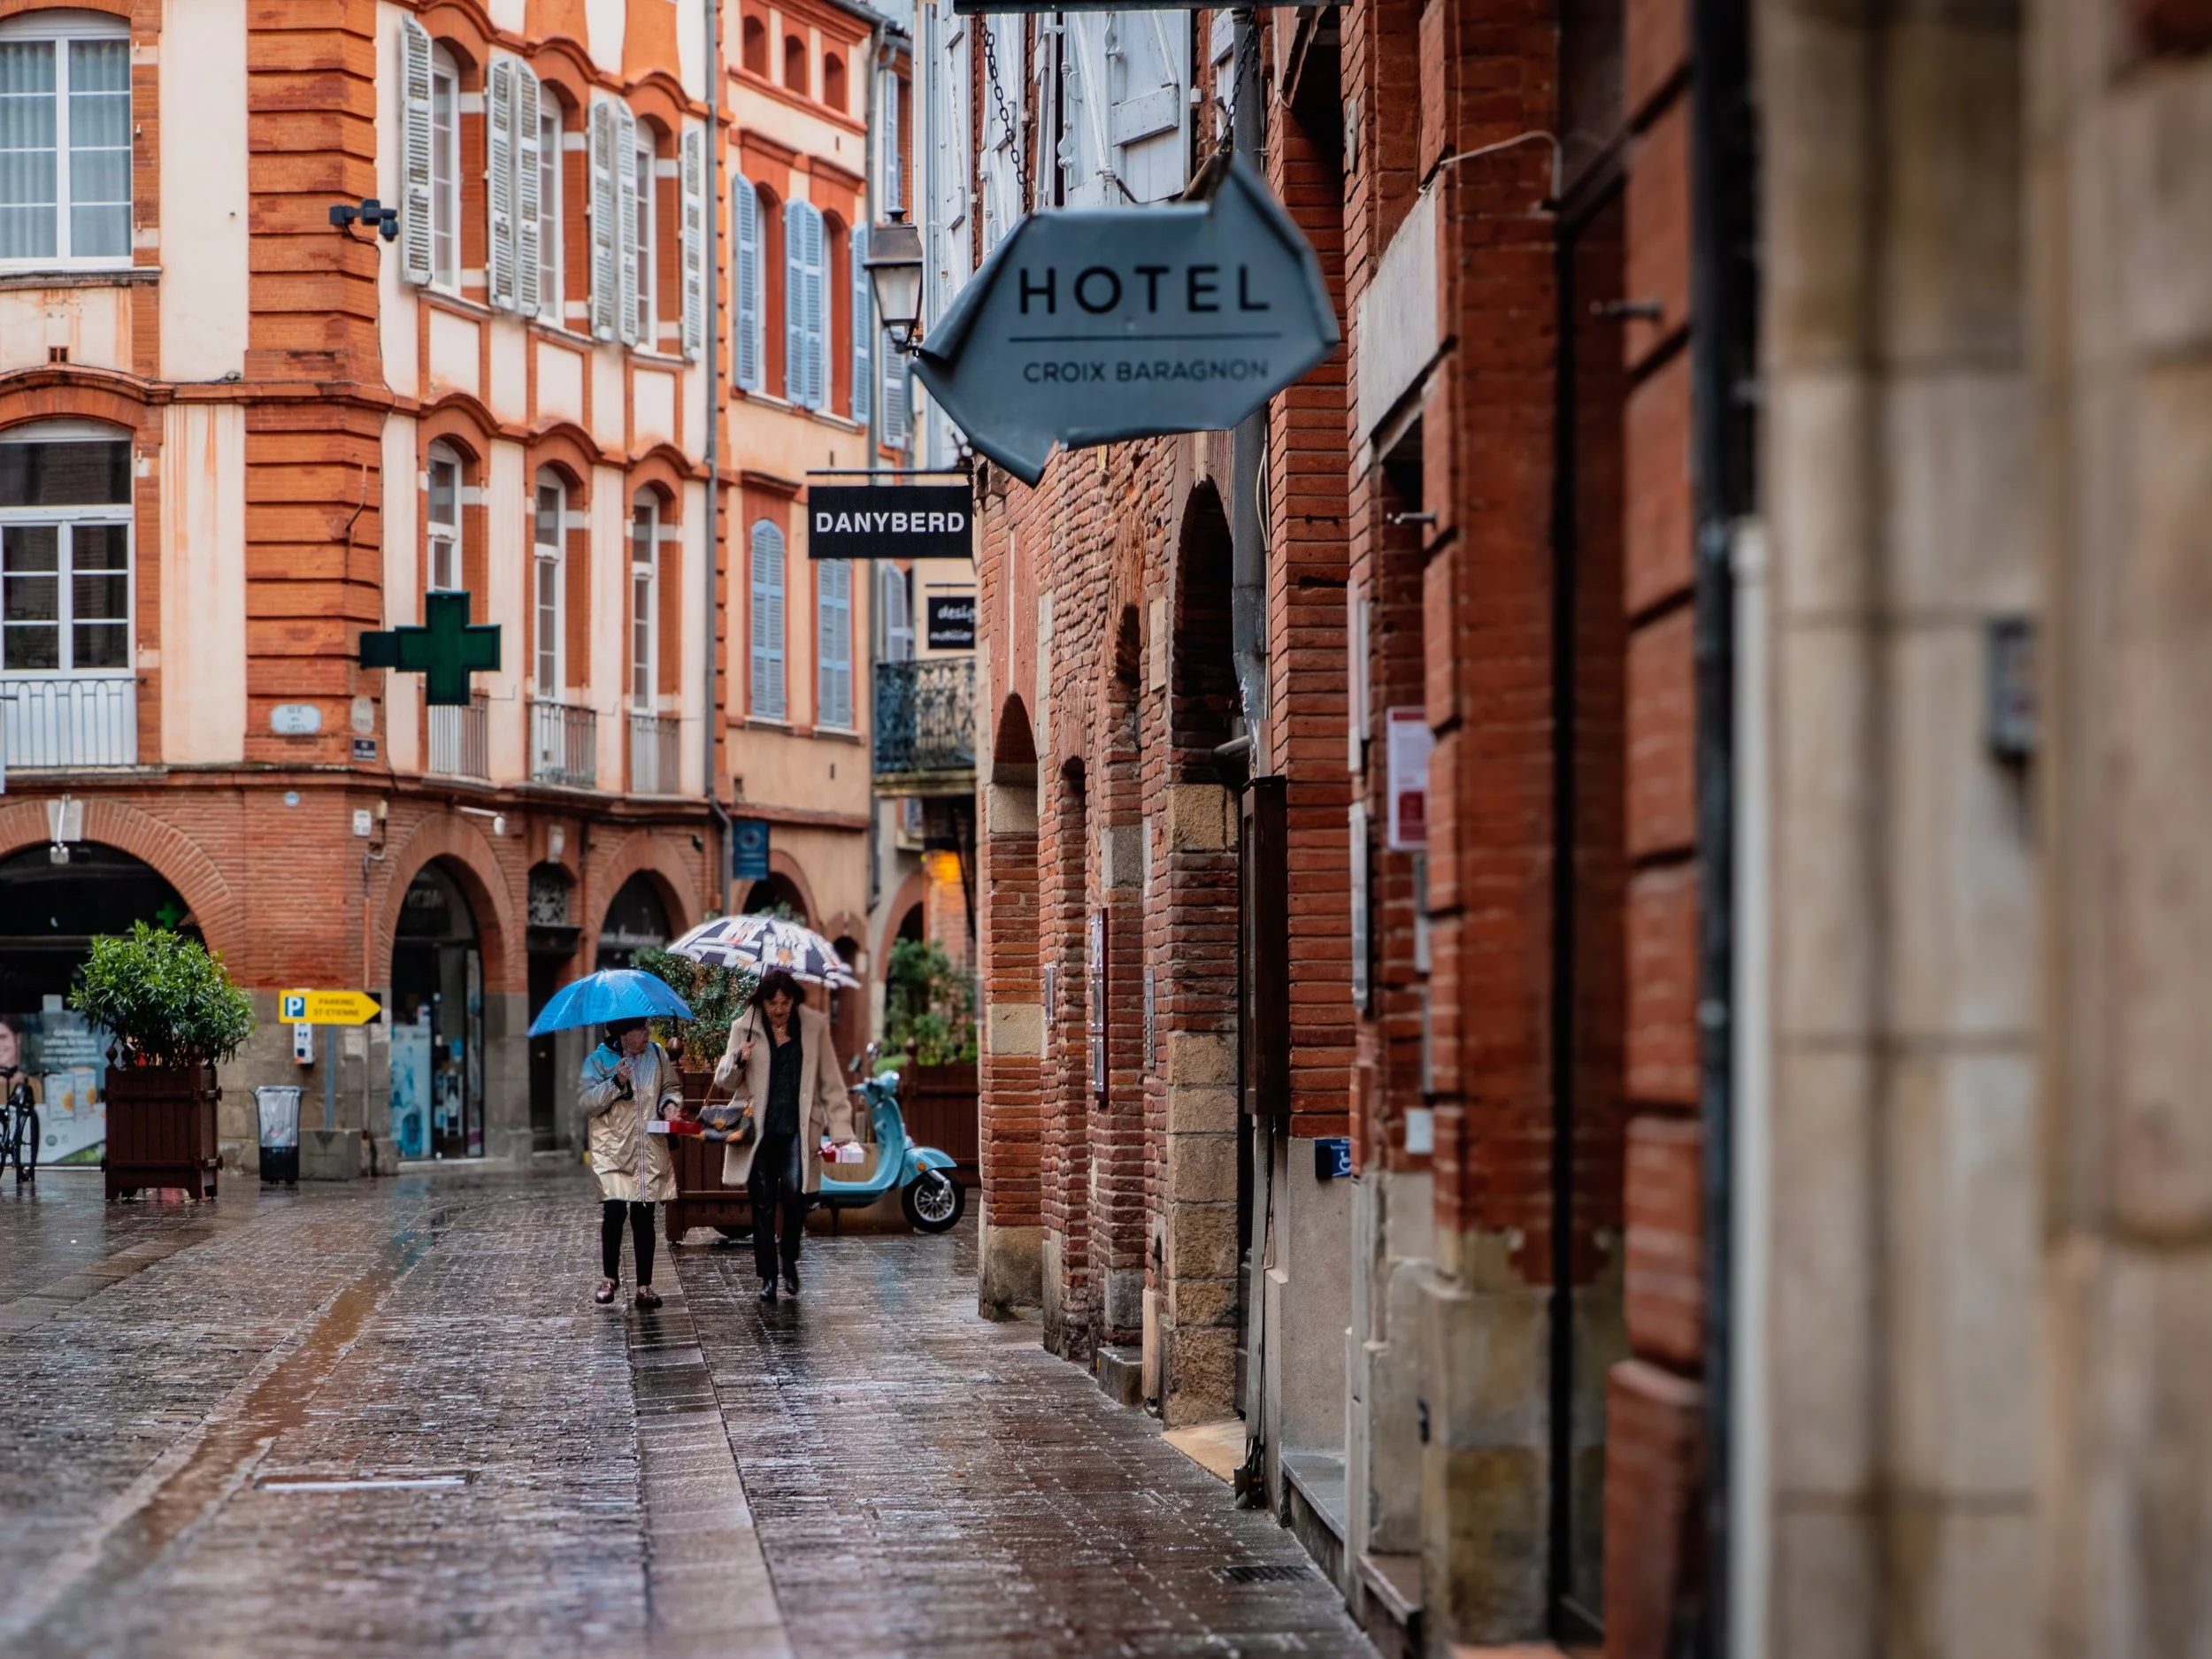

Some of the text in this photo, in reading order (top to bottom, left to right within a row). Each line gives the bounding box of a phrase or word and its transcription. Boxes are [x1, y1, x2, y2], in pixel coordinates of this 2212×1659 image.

[1019, 265, 1270, 314] HOTEL
[1023, 358, 1269, 383] CROIX BARAGNON
[816, 512, 964, 533] DANYBERD
